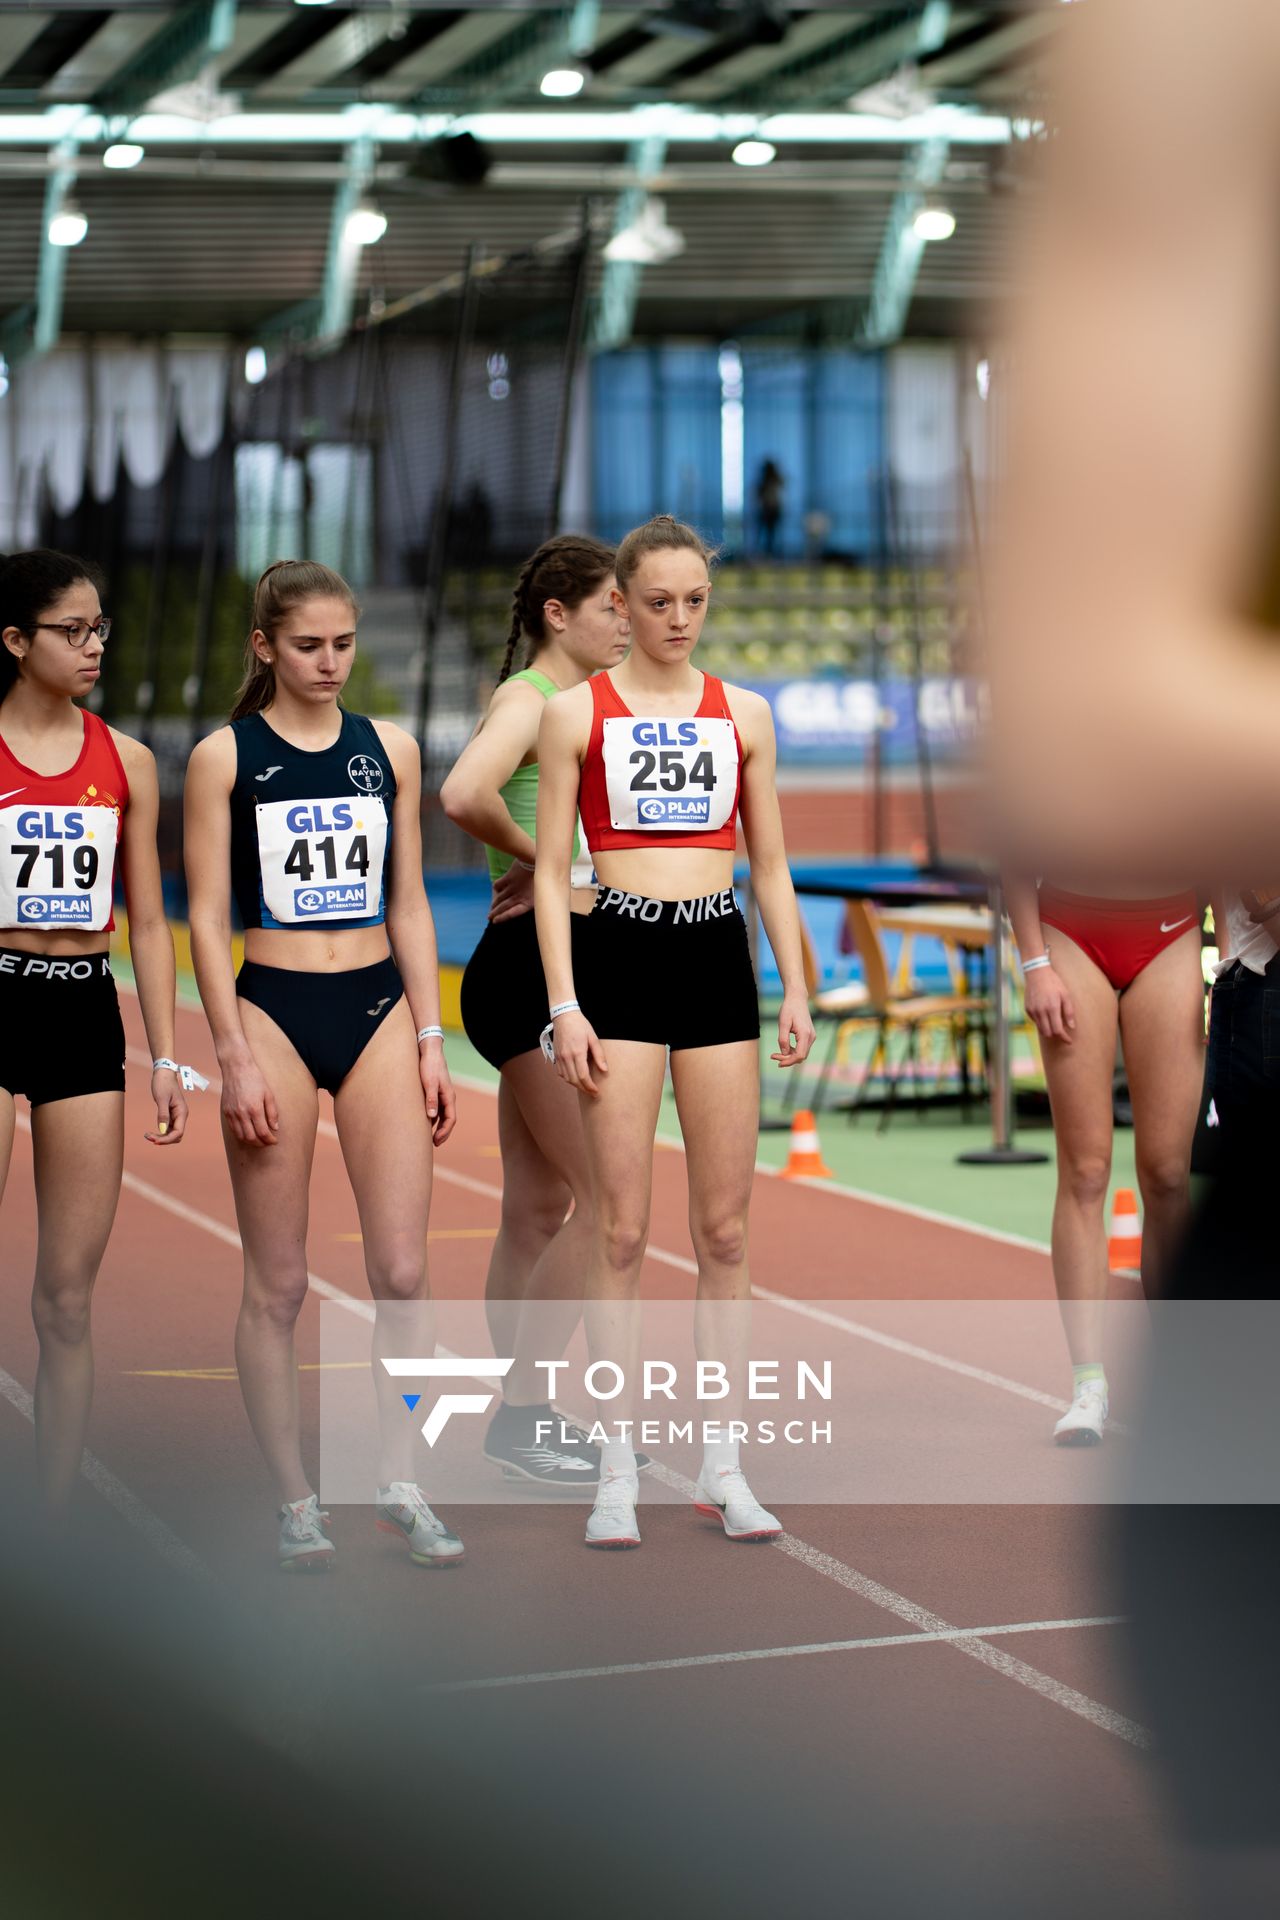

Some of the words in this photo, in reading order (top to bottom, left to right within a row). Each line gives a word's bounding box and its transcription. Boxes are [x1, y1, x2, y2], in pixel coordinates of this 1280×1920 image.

[629, 750, 717, 792] 254
[668, 802, 707, 814] PLAN
[11, 844, 98, 890] 719
[284, 835, 369, 881] 414
[51, 899, 90, 913] PLAN
[326, 888, 364, 903] PLAN
[600, 889, 663, 922] PRO
[673, 890, 733, 924] NIKE
[22, 958, 93, 980] PRO
